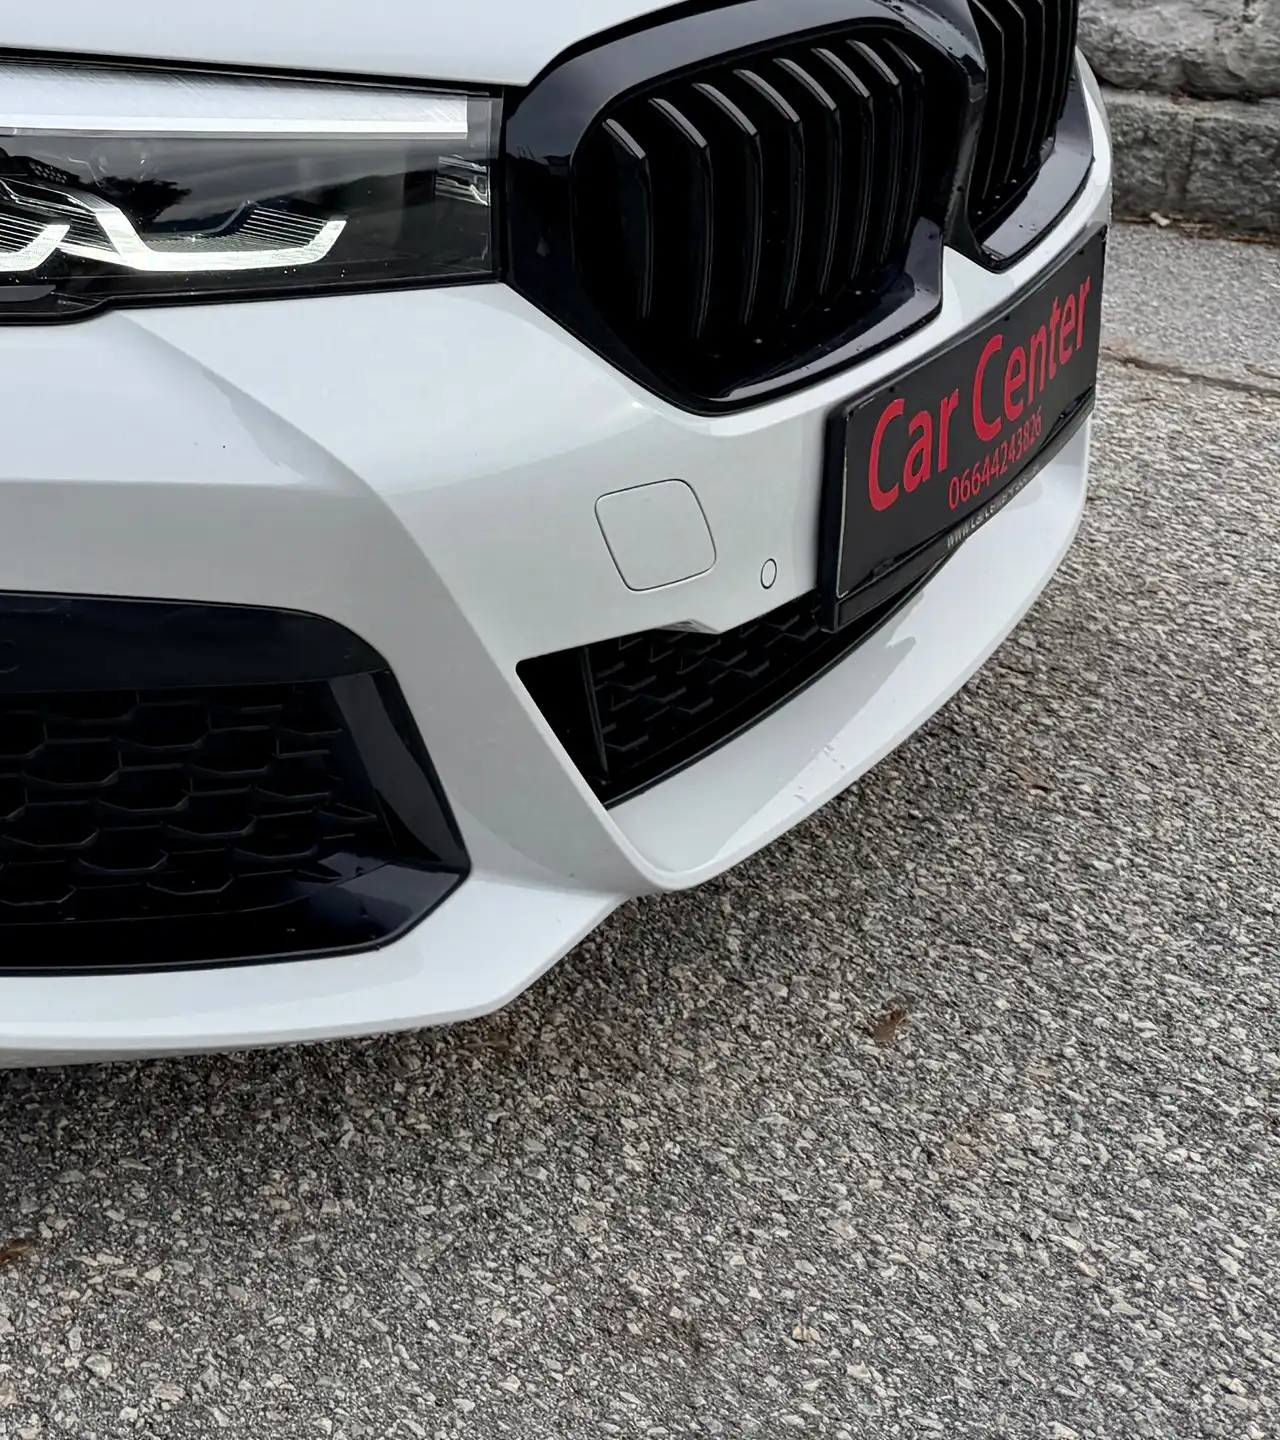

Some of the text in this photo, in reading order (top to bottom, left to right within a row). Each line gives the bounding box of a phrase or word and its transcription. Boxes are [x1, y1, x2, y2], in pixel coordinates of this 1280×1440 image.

[868, 388, 959, 511] Car
[973, 276, 1090, 442] Center
[948, 405, 1043, 511] 06644243826
